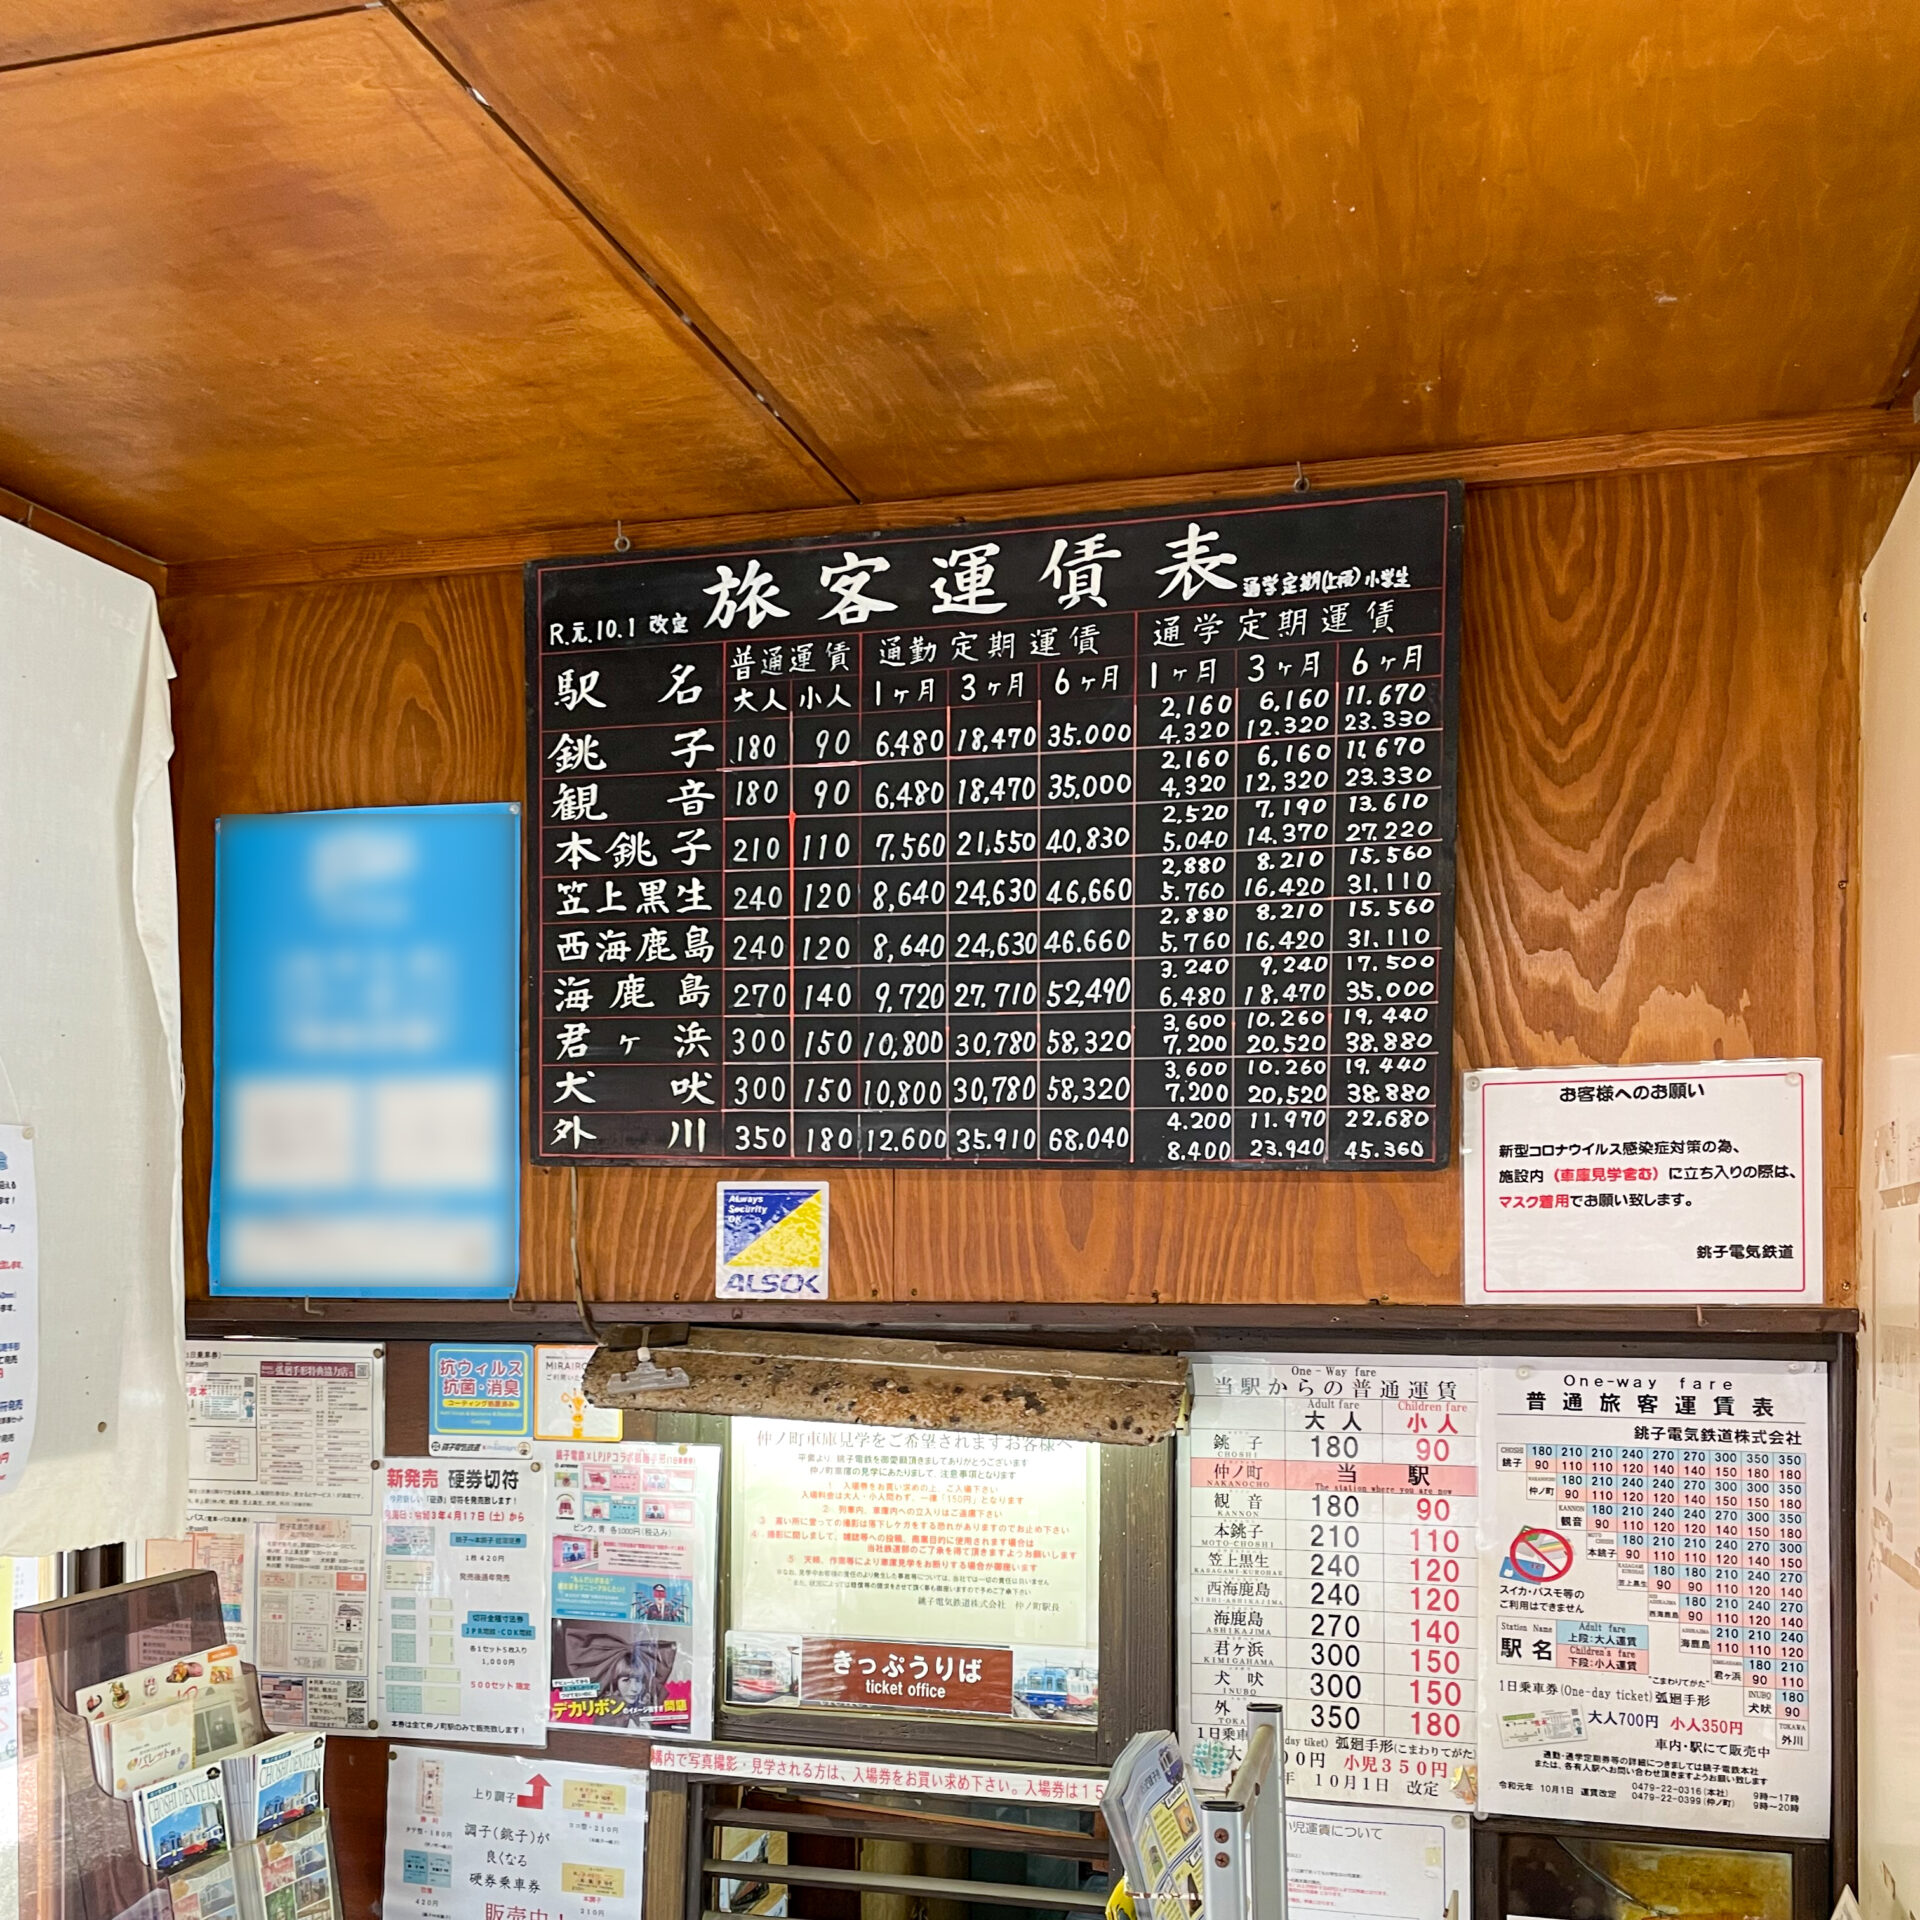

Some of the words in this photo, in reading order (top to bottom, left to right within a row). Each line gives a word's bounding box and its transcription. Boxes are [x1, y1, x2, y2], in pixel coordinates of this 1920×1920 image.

[703, 522, 1238, 631] 旅客運賃表
[649, 612, 689, 635] 改定
[1154, 599, 1396, 648] 通学定期運賃
[879, 624, 1100, 667] 通勤定期運賃
[730, 640, 851, 682] 普通運賃
[554, 663, 703, 711] 駅名
[733, 687, 787, 713] 大人
[800, 682, 851, 710] 小人
[547, 728, 715, 773] 銚子
[738, 734, 776, 761] 180
[816, 729, 850, 759] 90
[551, 779, 715, 821] 観音
[736, 780, 779, 806] 180
[814, 780, 850, 809] 90
[554, 829, 712, 870] 本銚子
[733, 838, 780, 862] 210
[803, 833, 850, 861] 110
[556, 878, 712, 916] 笠上黒生
[733, 886, 782, 911] 240
[804, 883, 851, 912] 120
[557, 925, 715, 963] 西海鹿島
[733, 935, 784, 960] 240
[803, 936, 850, 961] 120
[553, 973, 711, 1011] 海鹿島
[734, 983, 787, 1008] 270
[805, 983, 851, 1010] 140
[555, 1021, 712, 1060] 君ヶ浜
[732, 1028, 786, 1055] 300
[805, 1030, 852, 1058] 150
[553, 1071, 715, 1104] 犬吠
[734, 1076, 786, 1105] 300
[804, 1078, 852, 1103] 150
[1560, 1083, 1704, 1103] お客様へのお願い
[550, 1115, 706, 1150] 外川
[735, 1125, 787, 1151] 350
[808, 1127, 853, 1153] 180
[1499, 1140, 1739, 1158] 新型コロナウイルス感染症対策の為、
[728, 1205, 768, 1214] Security
[1499, 1193, 1693, 1209] マスク着用でお願い致します。
[1697, 1245, 1794, 1260] 銚子電気鉄道
[724, 1274, 820, 1293] ALSOK
[440, 1359, 522, 1376] 抗ウィルス
[1292, 1366, 1310, 1377] One
[1326, 1366, 1347, 1378] Way
[1355, 1366, 1376, 1377] fare
[443, 1378, 520, 1396] 抗菌・消臭
[1215, 1377, 1456, 1400] 当駅からの普通運賃
[1680, 1377, 1733, 1390] fare
[1308, 1400, 1335, 1409] Adult
[1340, 1400, 1359, 1410] fare
[1398, 1402, 1438, 1412] Children
[1443, 1402, 1467, 1413] fare
[1526, 1391, 1774, 1417] 普通旅客運賃表
[1304, 1410, 1362, 1431] 大人
[1406, 1412, 1458, 1434] 小人
[1634, 1426, 1802, 1446] 銚子電気鉄道株式会社
[1214, 1434, 1262, 1450] 銚子
[1311, 1435, 1358, 1458] 180
[1416, 1438, 1450, 1462] 90
[1502, 1458, 1522, 1468] 銚子
[1532, 1446, 1552, 1456] 180
[1778, 1455, 1801, 1465] 350
[386, 1468, 438, 1489] 新発売
[448, 1469, 519, 1490] 硬券切符
[1215, 1464, 1262, 1480] 仲ノ町
[1215, 1493, 1262, 1509] 観音
[1312, 1494, 1359, 1518] 180
[1416, 1497, 1450, 1521] 90
[1561, 1516, 1582, 1527] 観音
[1214, 1523, 1263, 1539] 本銚子
[1311, 1524, 1359, 1548] 210
[1410, 1529, 1459, 1554] 110
[1209, 1552, 1269, 1568] 笠上黒生
[1311, 1554, 1360, 1578] 240
[1410, 1558, 1460, 1583] 120
[1208, 1581, 1270, 1597] 西海鹿島
[1311, 1582, 1360, 1606] 240
[1410, 1587, 1460, 1612] 120
[1500, 1600, 1584, 1614] ご利用はできません
[1214, 1610, 1263, 1627] 海鹿島
[1311, 1614, 1360, 1638] 270
[1410, 1618, 1460, 1644] 140
[1501, 1622, 1527, 1632] Station
[1533, 1624, 1552, 1633] Name
[1214, 1640, 1264, 1657] 君ヶ浜
[1311, 1642, 1360, 1668] 300
[1410, 1649, 1460, 1674] 150
[1501, 1638, 1552, 1661] 駅名
[832, 1650, 983, 1684] きっぷうりば
[865, 1679, 902, 1696] ticket
[908, 1680, 946, 1698] office
[1214, 1670, 1264, 1686] 犬吠
[1310, 1672, 1361, 1700] 300
[1410, 1679, 1462, 1707] 150
[1311, 1704, 1360, 1730] 350
[1411, 1710, 1460, 1738] 180
[1588, 1710, 1658, 1729] 大人700円
[1670, 1717, 1743, 1735] 小人350円
[1655, 1738, 1770, 1758] 車内・駅にて販売中
[1781, 1735, 1803, 1746] 外川
[1344, 1754, 1448, 1779] 小児350円
[473, 1788, 516, 1803] 上り調子
[1407, 1780, 1439, 1797] 改定
[487, 1849, 527, 1867] 良くなる
[469, 1873, 541, 1894] 硬券乗車券
